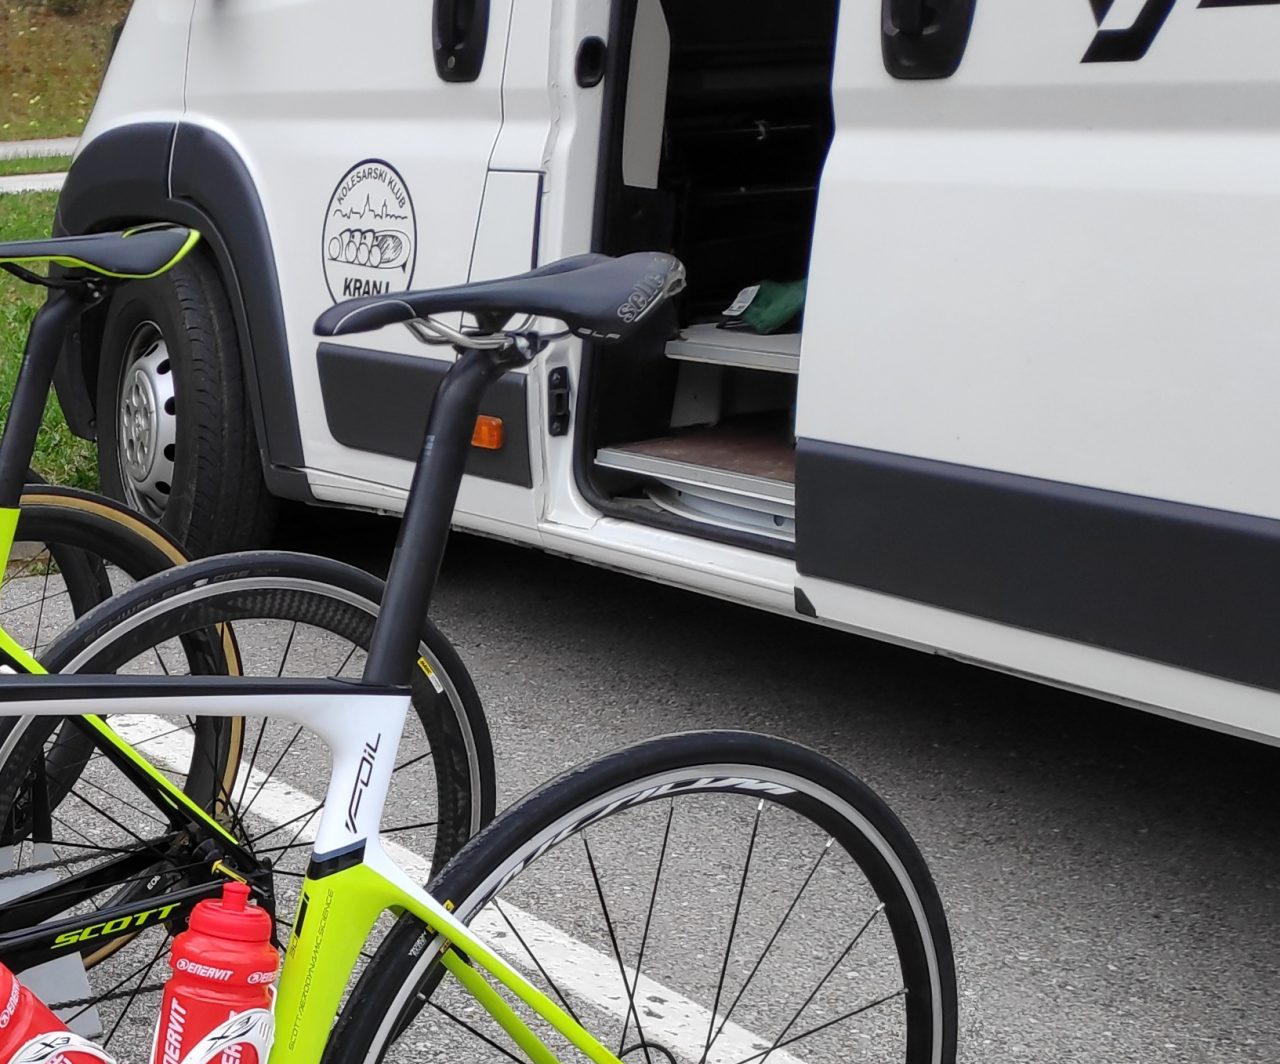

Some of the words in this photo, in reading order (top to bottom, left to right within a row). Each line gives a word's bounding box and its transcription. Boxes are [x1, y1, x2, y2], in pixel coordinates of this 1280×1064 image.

[336, 167, 387, 206] KOLESARSKI
[387, 176, 406, 209] KLUB
[50, 902, 182, 950] SCOTT
[188, 962, 234, 981] ENERVIT
